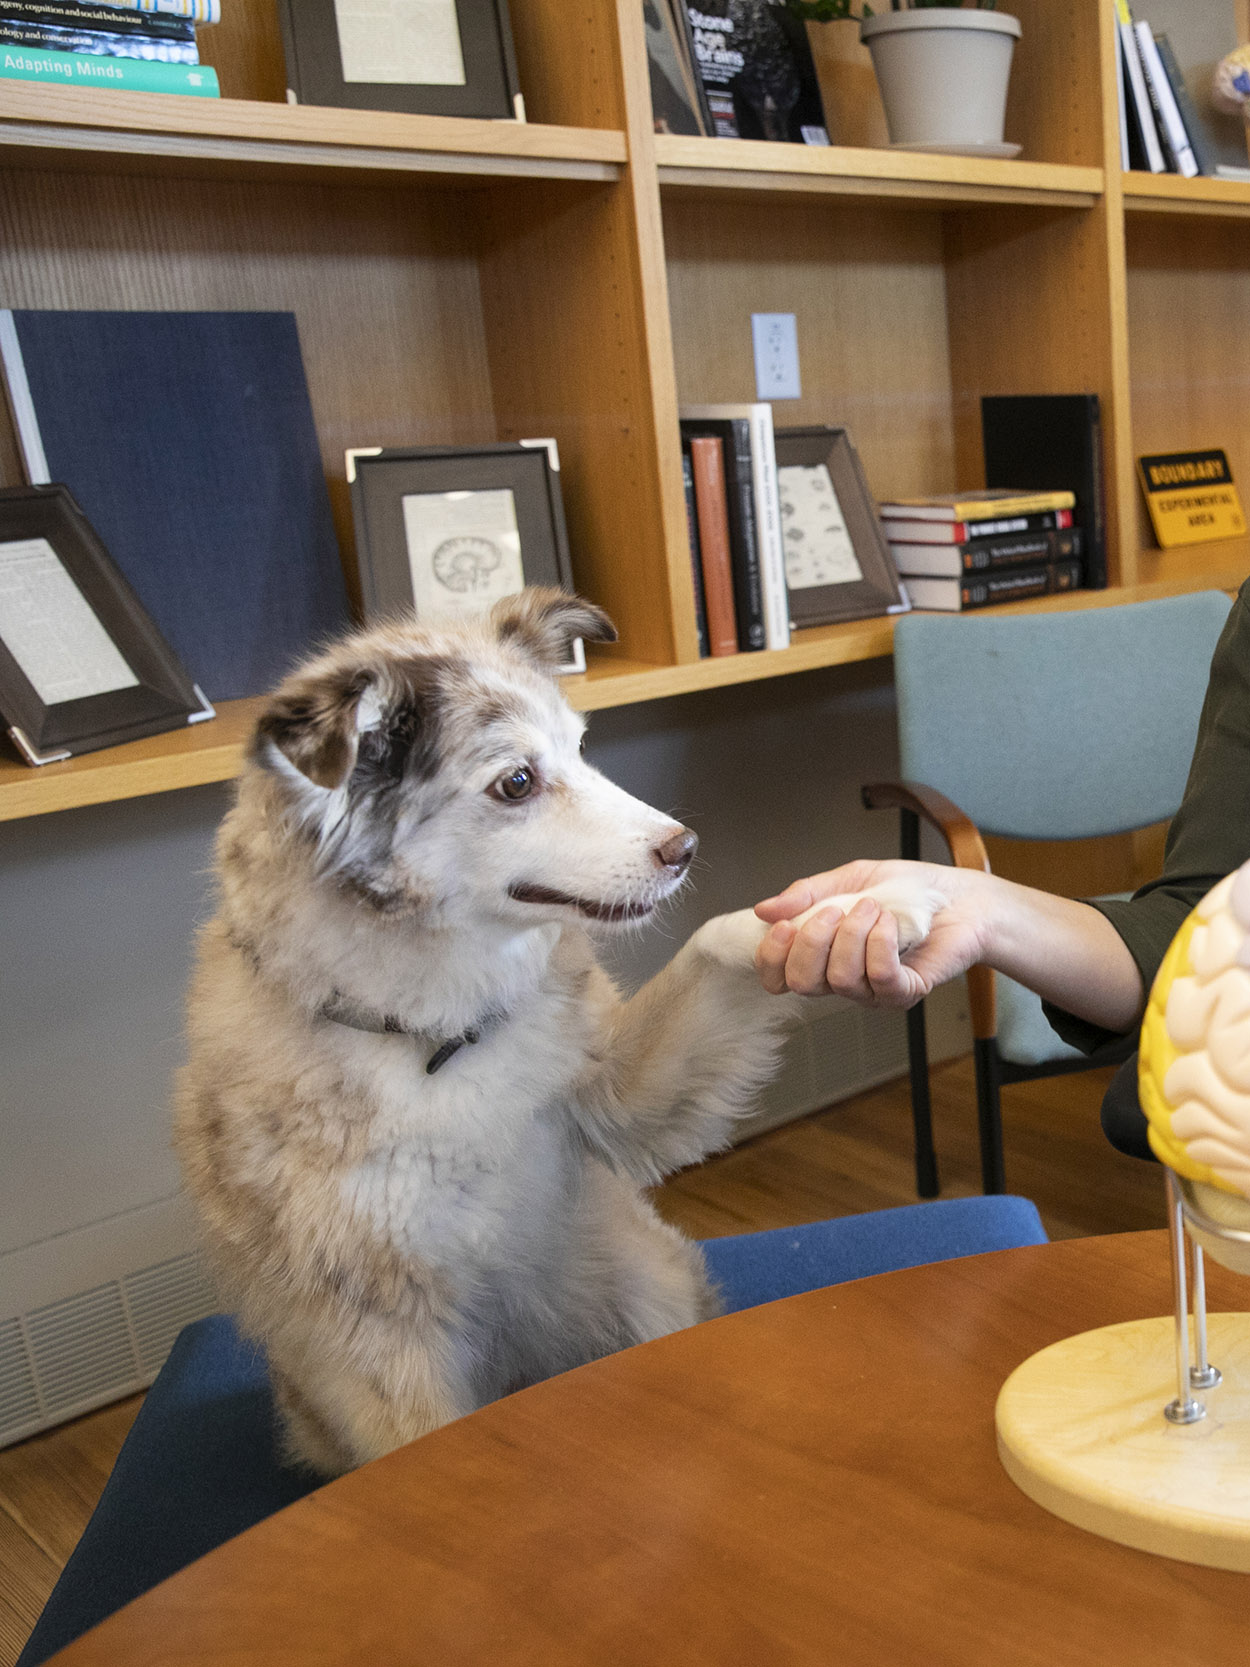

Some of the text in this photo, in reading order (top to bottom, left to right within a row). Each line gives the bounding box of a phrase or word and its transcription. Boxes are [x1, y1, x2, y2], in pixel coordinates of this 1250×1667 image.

[24, 4, 64, 14] cognition
[65, 8, 80, 17] and
[81, 11, 103, 20] social
[103, 11, 142, 24] behaviour
[688, 7, 734, 33] Stone
[25, 31, 41, 39] and
[41, 34, 93, 45] conservation
[4, 55, 124, 78] Adapting Minds
[695, 44, 745, 67] Brains
[1149, 460, 1224, 485] BOUNDARY
